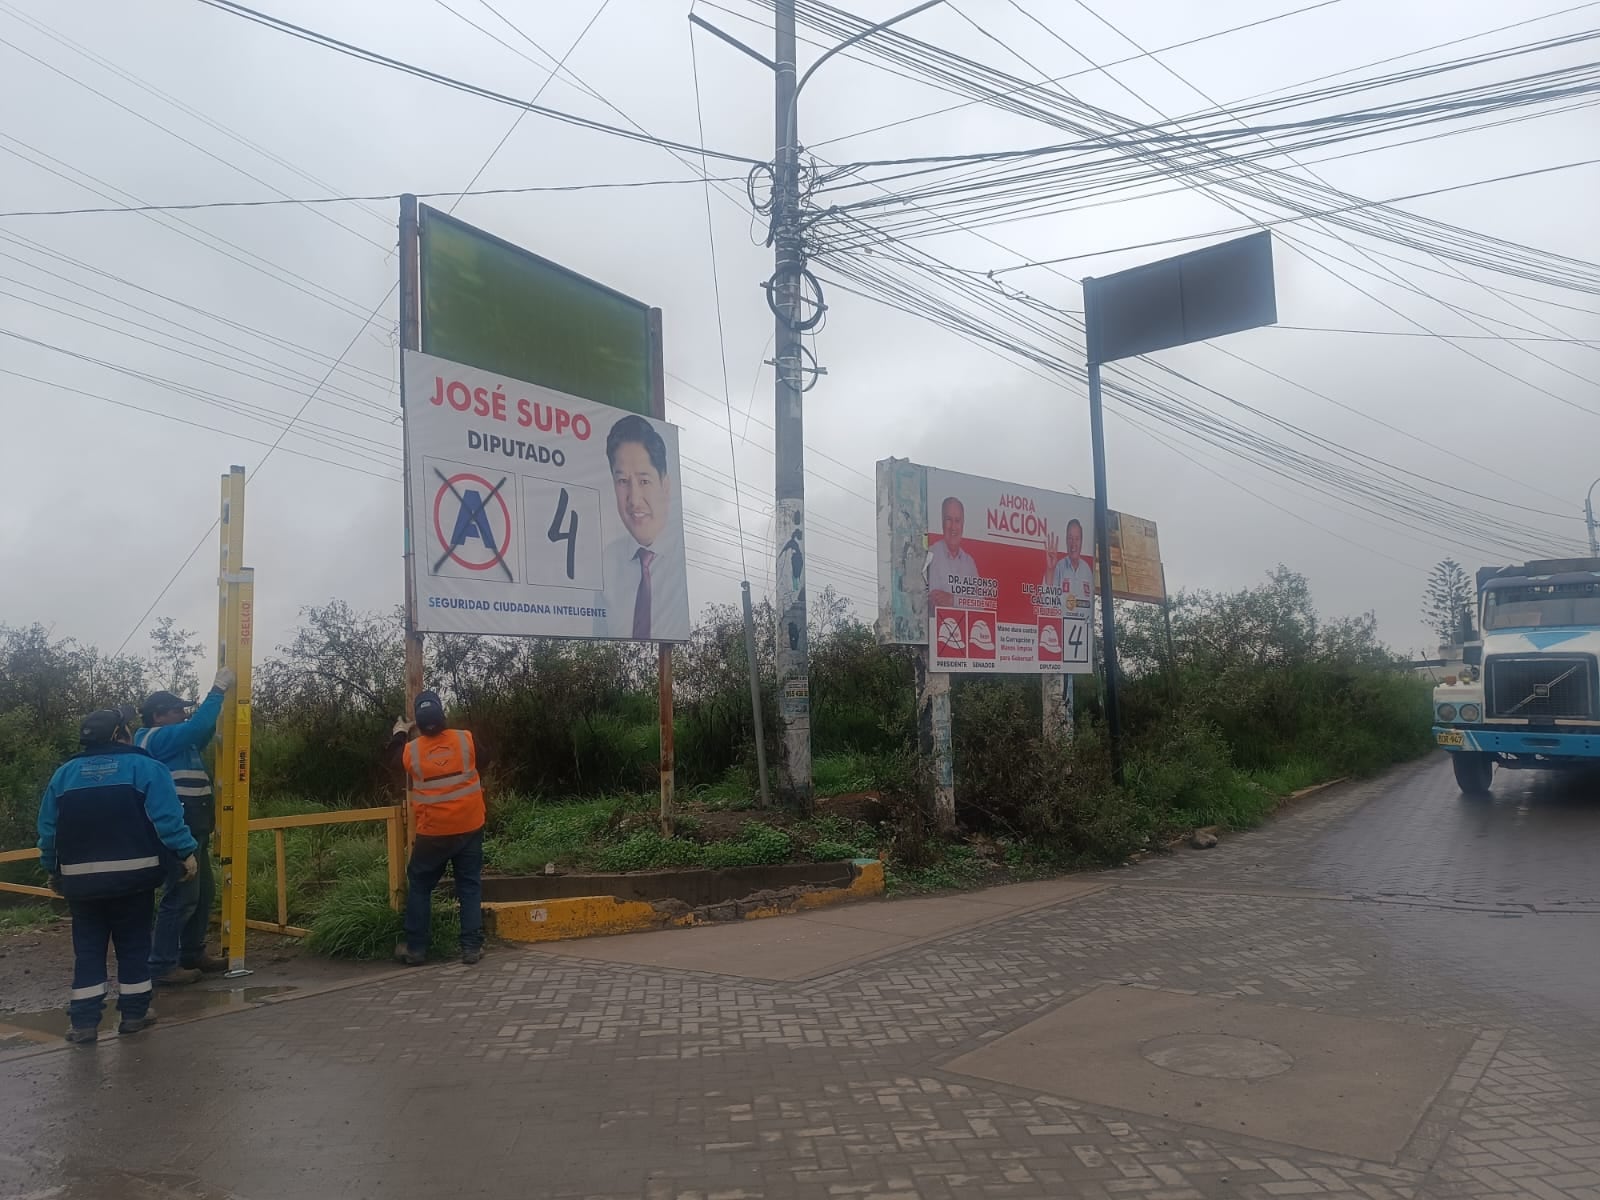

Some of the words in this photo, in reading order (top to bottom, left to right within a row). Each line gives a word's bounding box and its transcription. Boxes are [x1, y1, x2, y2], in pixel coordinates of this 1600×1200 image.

[430, 375, 507, 422] JOSÉ
[517, 398, 592, 441] SUPO
[467, 429, 566, 468] DIPUTADO
[999, 493, 1036, 513] AHORA
[987, 508, 1048, 537] NACIÓN
[547, 487, 579, 581] 4
[948, 574, 962, 585] DR.
[963, 576, 998, 589] ALFONSO
[951, 585, 976, 596] LOPEZ
[977, 587, 998, 598] CHAU
[1037, 585, 1063, 596] FLAVIO
[428, 596, 490, 612] SEGURIDAD
[493, 601, 551, 615] CIUDADANA
[552, 606, 607, 618] INTELIGENTE
[1068, 624, 1083, 659] 4
[937, 660, 968, 668] PRESIDENTE
